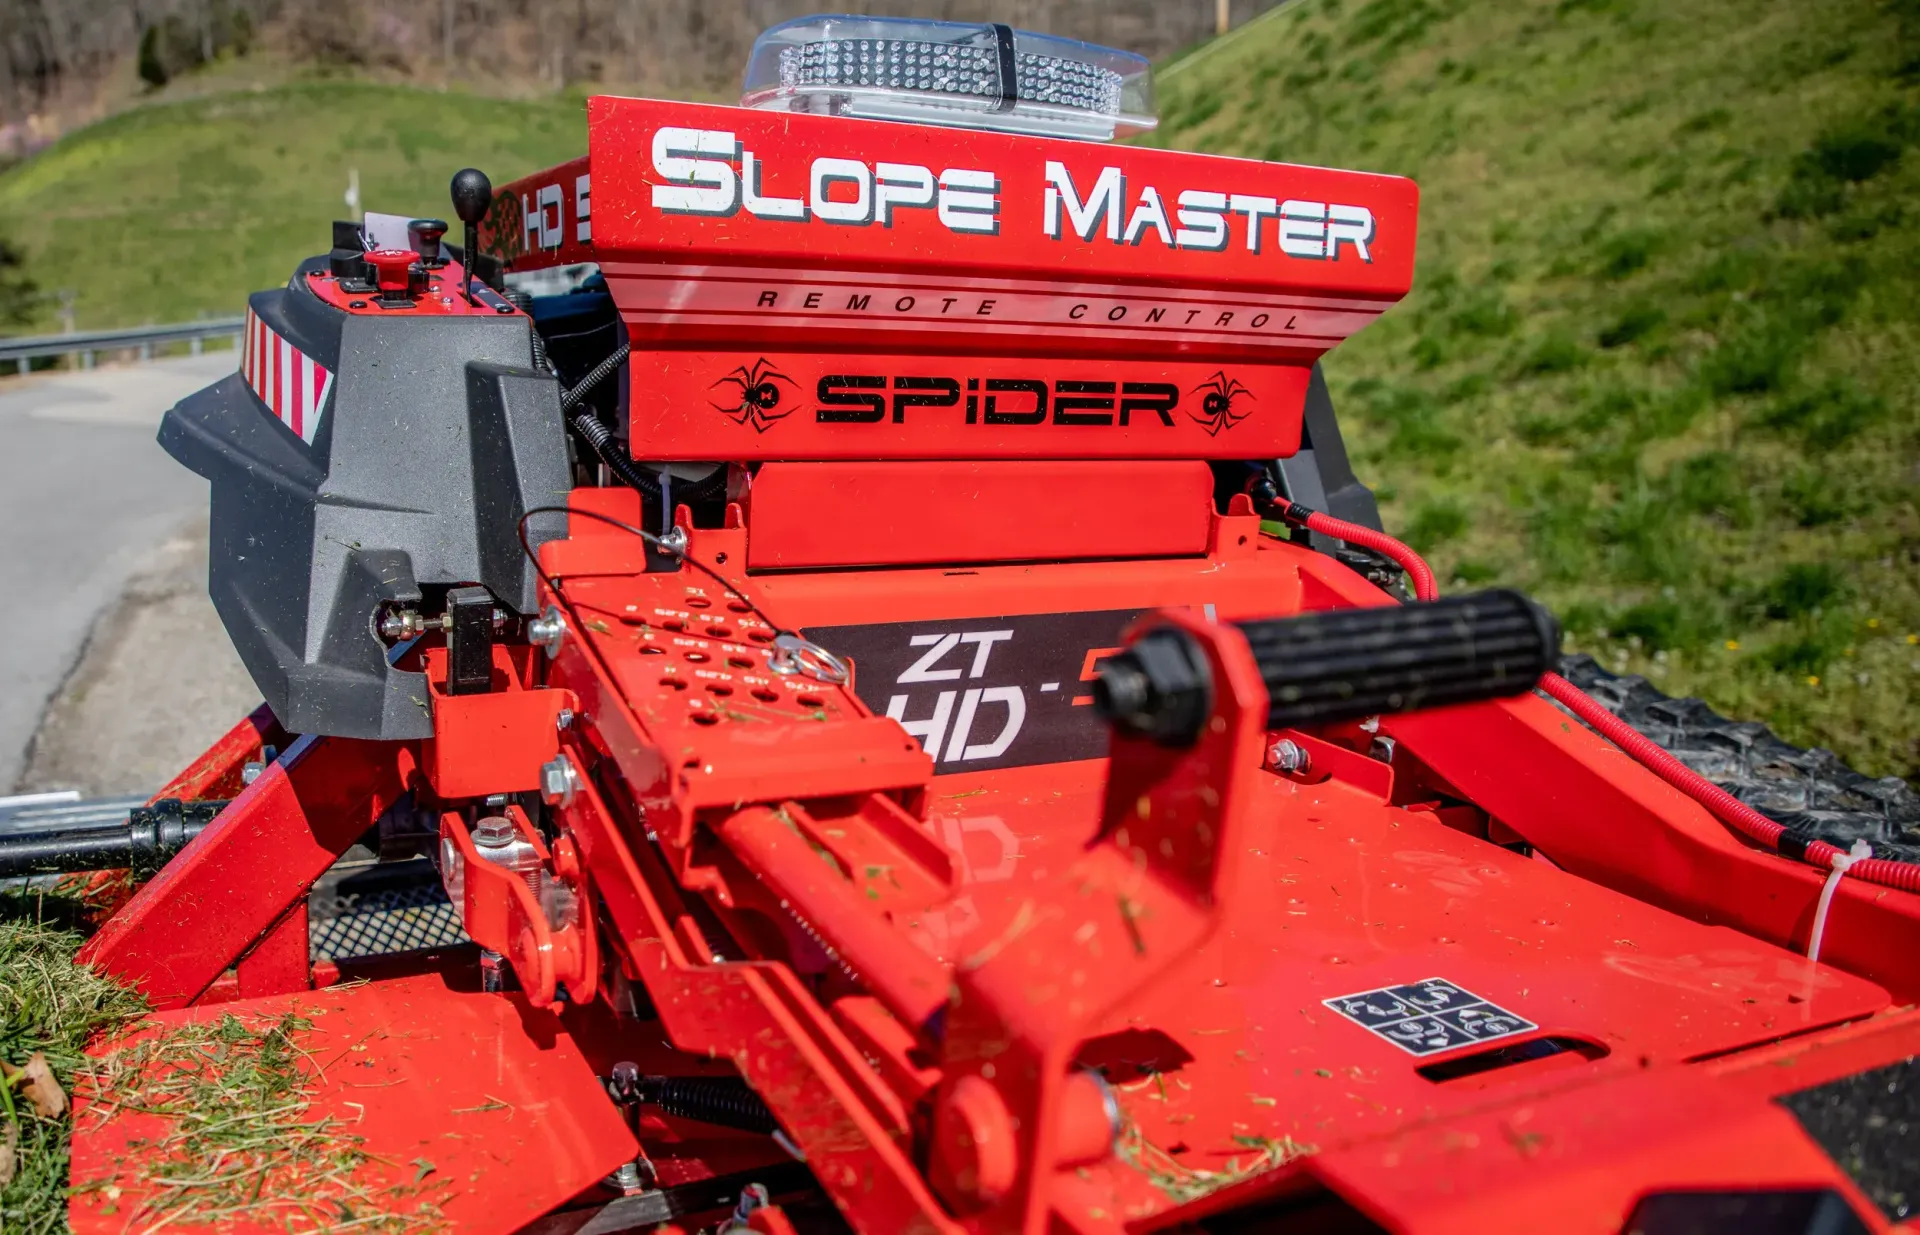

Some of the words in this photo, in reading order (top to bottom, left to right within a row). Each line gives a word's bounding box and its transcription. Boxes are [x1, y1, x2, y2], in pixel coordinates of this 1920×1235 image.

[522, 184, 564, 252] HD
[757, 290, 997, 317] REMOTE
[1069, 304, 1301, 331] CONTROL
[896, 629, 1014, 684] ZT
[886, 684, 1027, 763] HD
